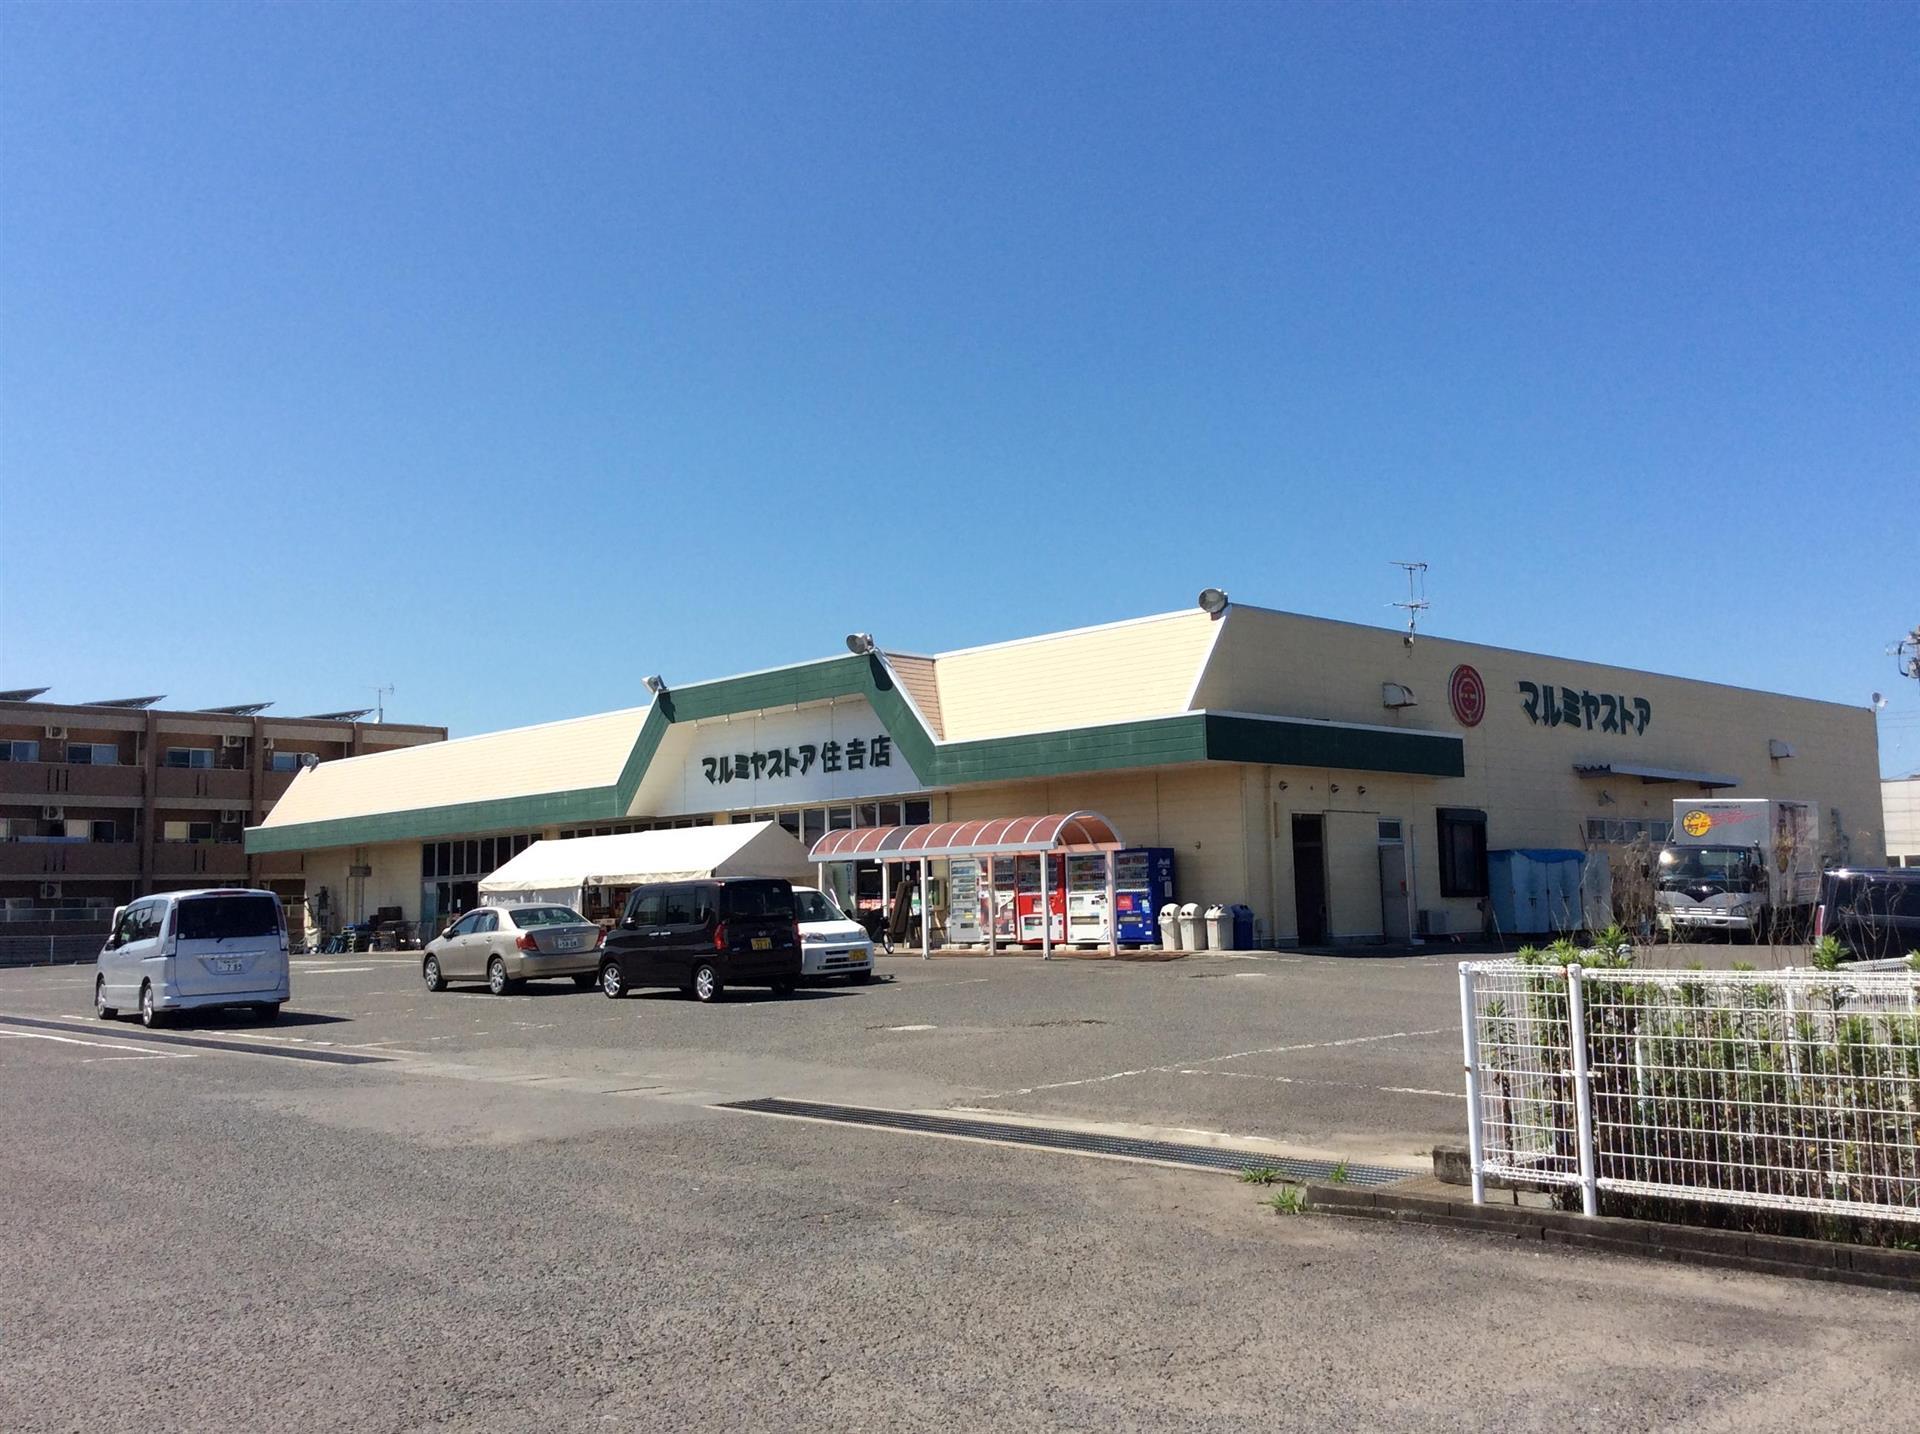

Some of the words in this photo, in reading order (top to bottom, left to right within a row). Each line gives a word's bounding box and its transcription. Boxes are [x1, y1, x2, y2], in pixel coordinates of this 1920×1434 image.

[1518, 680, 1651, 736] マルミヤストア
